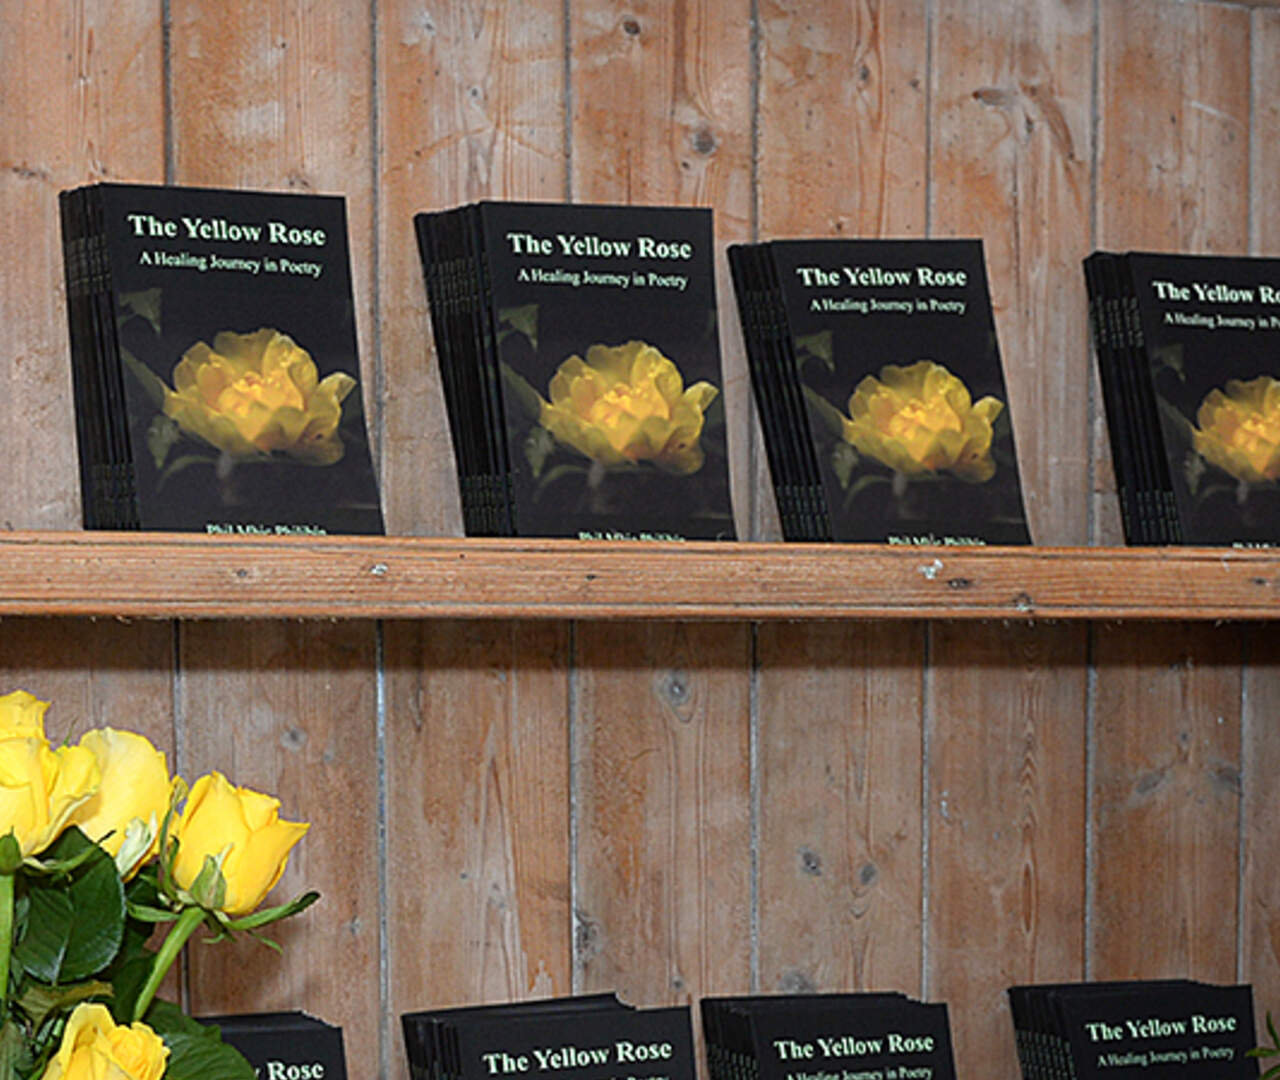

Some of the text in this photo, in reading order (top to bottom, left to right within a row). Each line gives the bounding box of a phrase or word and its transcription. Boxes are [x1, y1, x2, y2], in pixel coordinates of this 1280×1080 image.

[127, 214, 326, 246] The Yellow Rose
[506, 233, 691, 259] The Yellow Rose
[140, 251, 321, 278] A Healing Journey in Poetry
[518, 268, 687, 291] A Healing Journey in Poetry
[796, 267, 967, 286] The Yellow Rose
[1152, 281, 1190, 301] The
[1193, 283, 1254, 303] Yellow
[810, 298, 966, 315] A Healing Journey in Poetry
[1165, 312, 1174, 324] A
[1174, 312, 1216, 329] Healing
[1216, 314, 1256, 330] Journey
[1258, 318, 1269, 328] in
[1085, 1015, 1237, 1041] The Yellow Rose
[482, 1041, 672, 1074] The Yellow Rose
[773, 1034, 934, 1059] The Yellow Rose
[1098, 1046, 1234, 1067] A Healing Journey in Poetry
[886, 1070, 897, 1080] in
[898, 1066, 932, 1080] Poetry
